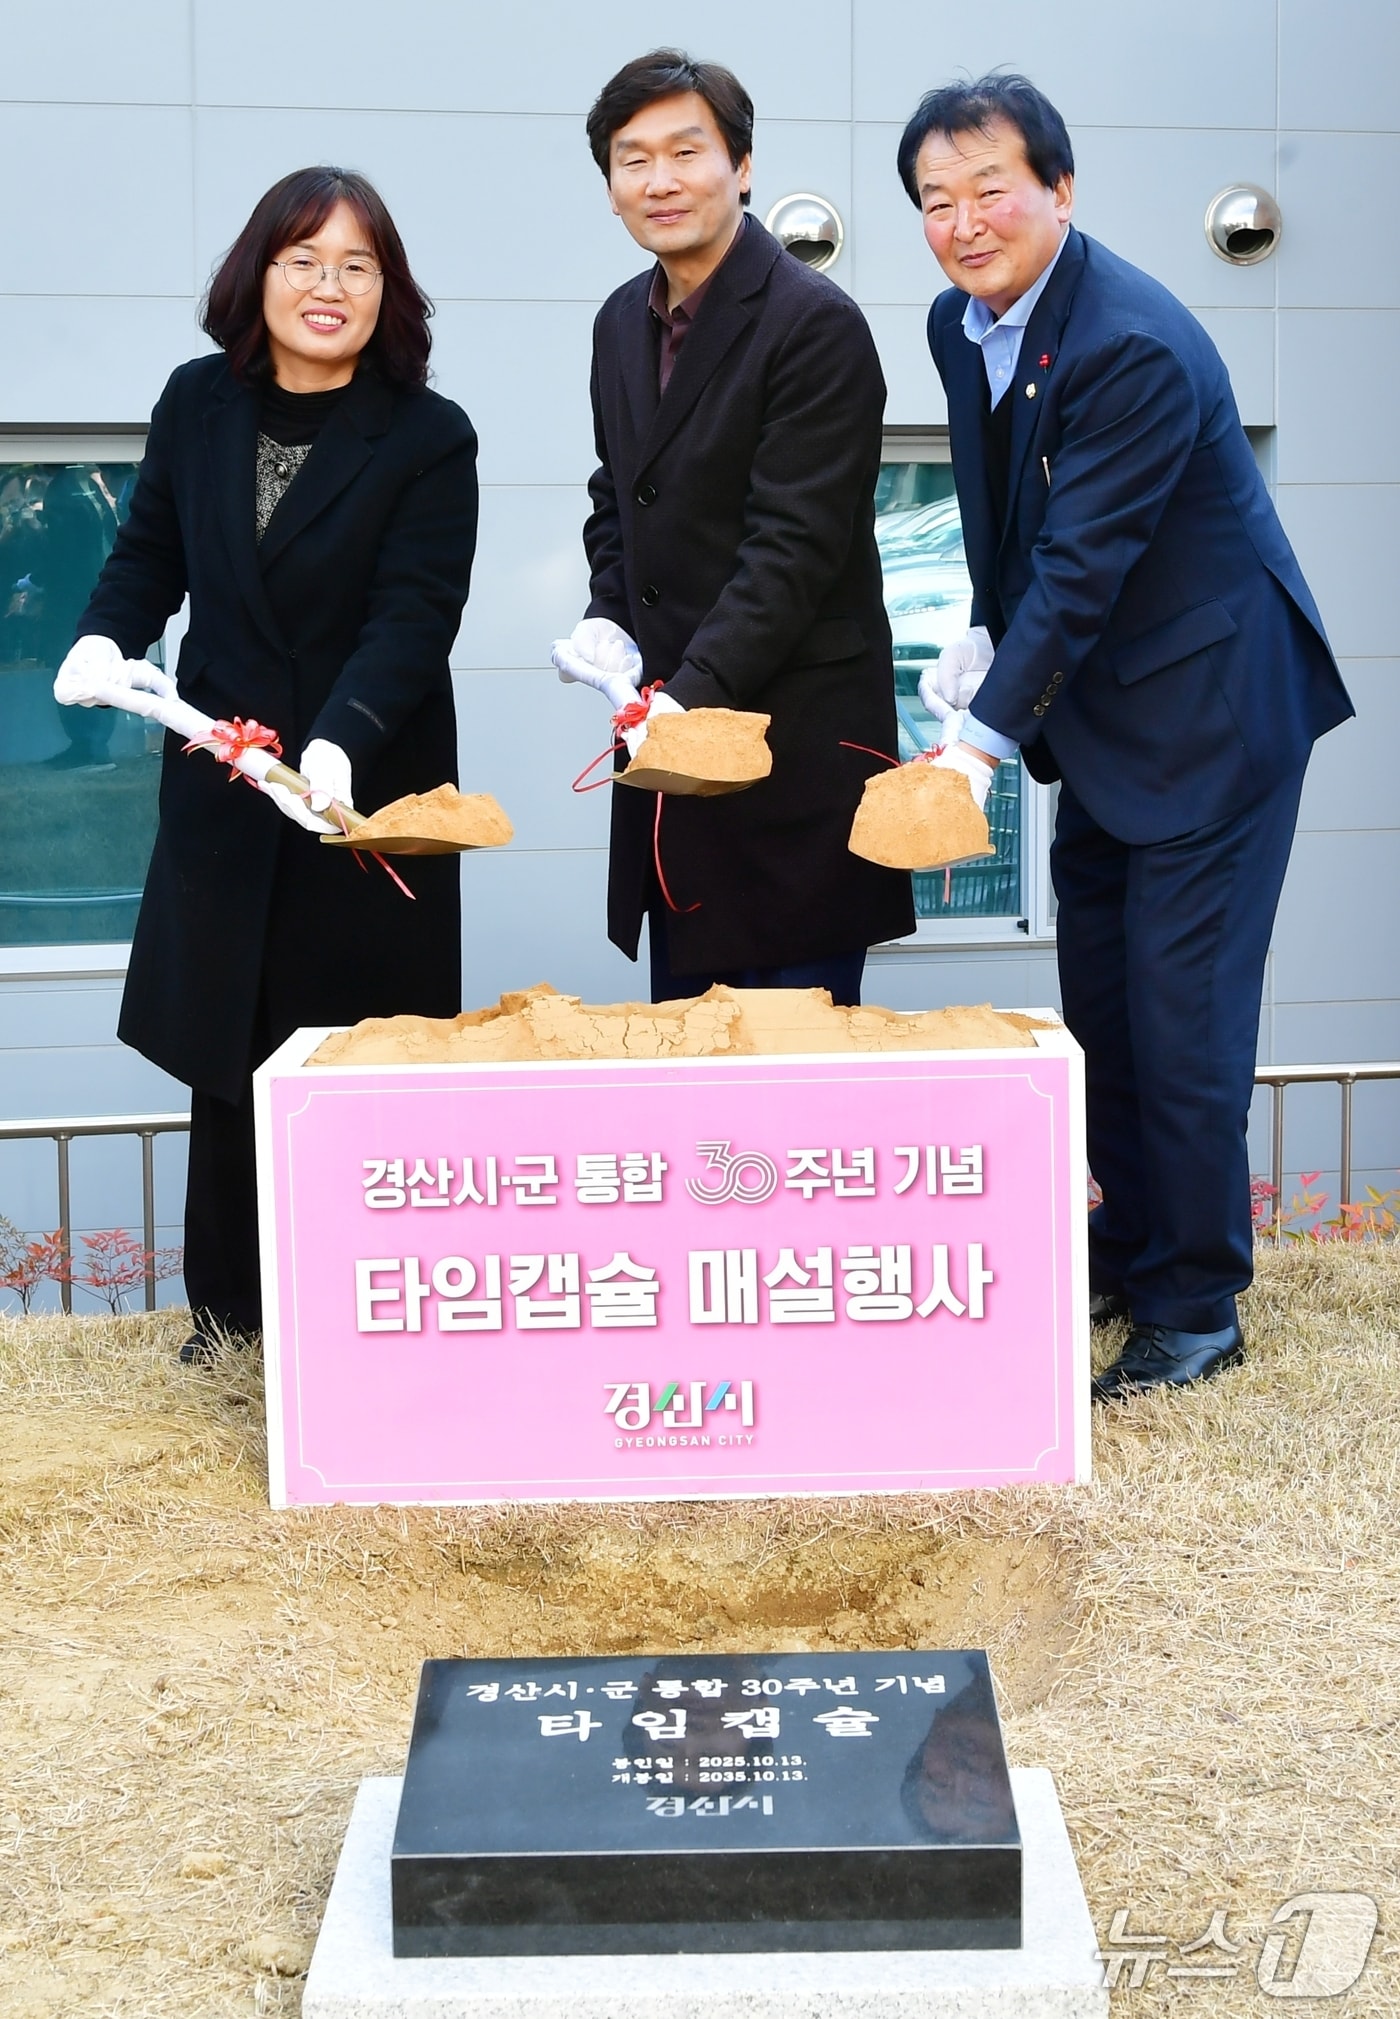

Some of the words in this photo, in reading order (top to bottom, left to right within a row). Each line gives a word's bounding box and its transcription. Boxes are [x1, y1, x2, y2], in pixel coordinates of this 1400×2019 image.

[361, 1155, 558, 1209] 경산시·군
[574, 1152, 667, 1203] 통합
[893, 1144, 984, 1196] 기념
[355, 1251, 661, 1333] 타임캡슐
[688, 1243, 994, 1325] 매설행사
[603, 1380, 755, 1431] 경산시
[614, 1436, 711, 1449] GYEONGSAN
[718, 1434, 754, 1446] CITY
[651, 1678, 729, 1700] 통합
[740, 1676, 860, 1698] 30주년
[873, 1674, 947, 1695] 기념
[698, 1755, 807, 1768] 2025.10.13.
[611, 1771, 674, 1784] 개봉일
[698, 1770, 809, 1783] 2035.10.13.
[645, 1795, 774, 1817] 경산시
